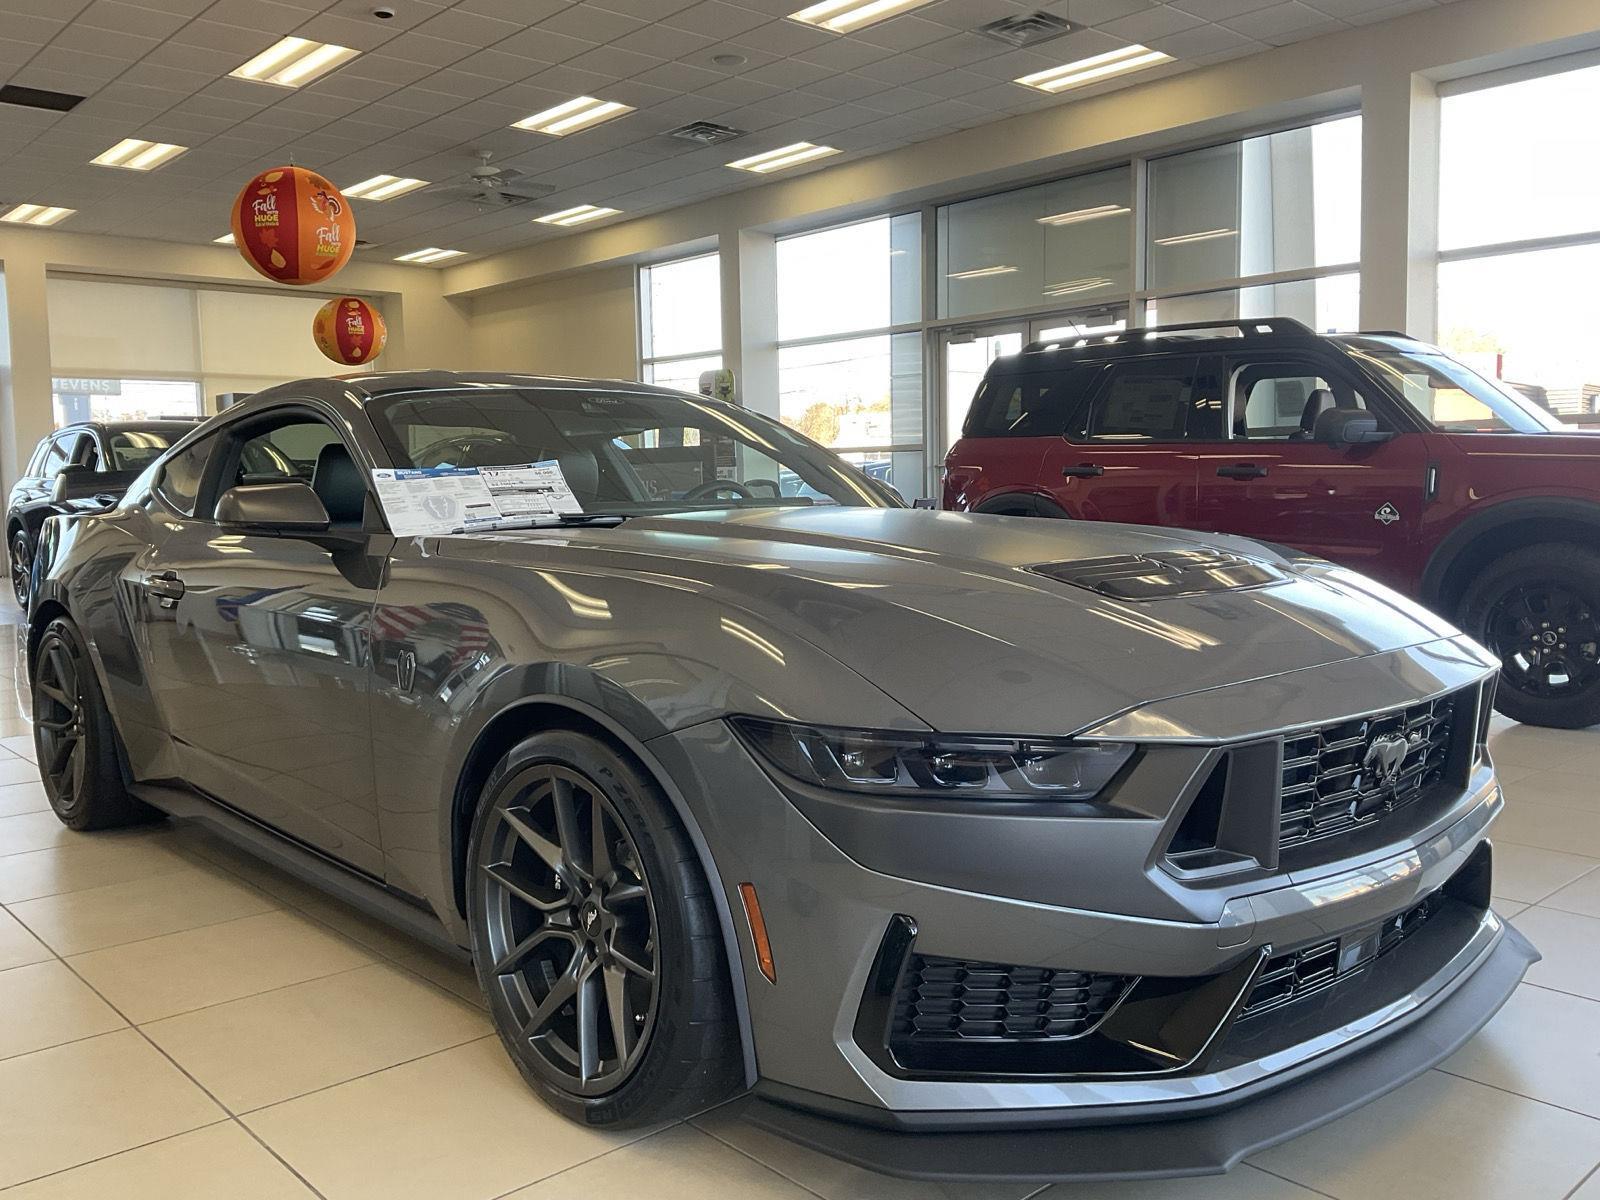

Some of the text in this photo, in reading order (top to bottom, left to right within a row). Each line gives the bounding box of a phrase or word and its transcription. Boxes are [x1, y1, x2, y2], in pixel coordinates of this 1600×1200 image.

[252, 194, 276, 215] Fall
[254, 214, 279, 222] HUGE
[316, 222, 340, 245] Fall
[316, 244, 340, 253] HUGE
[346, 315, 362, 327] Fall
